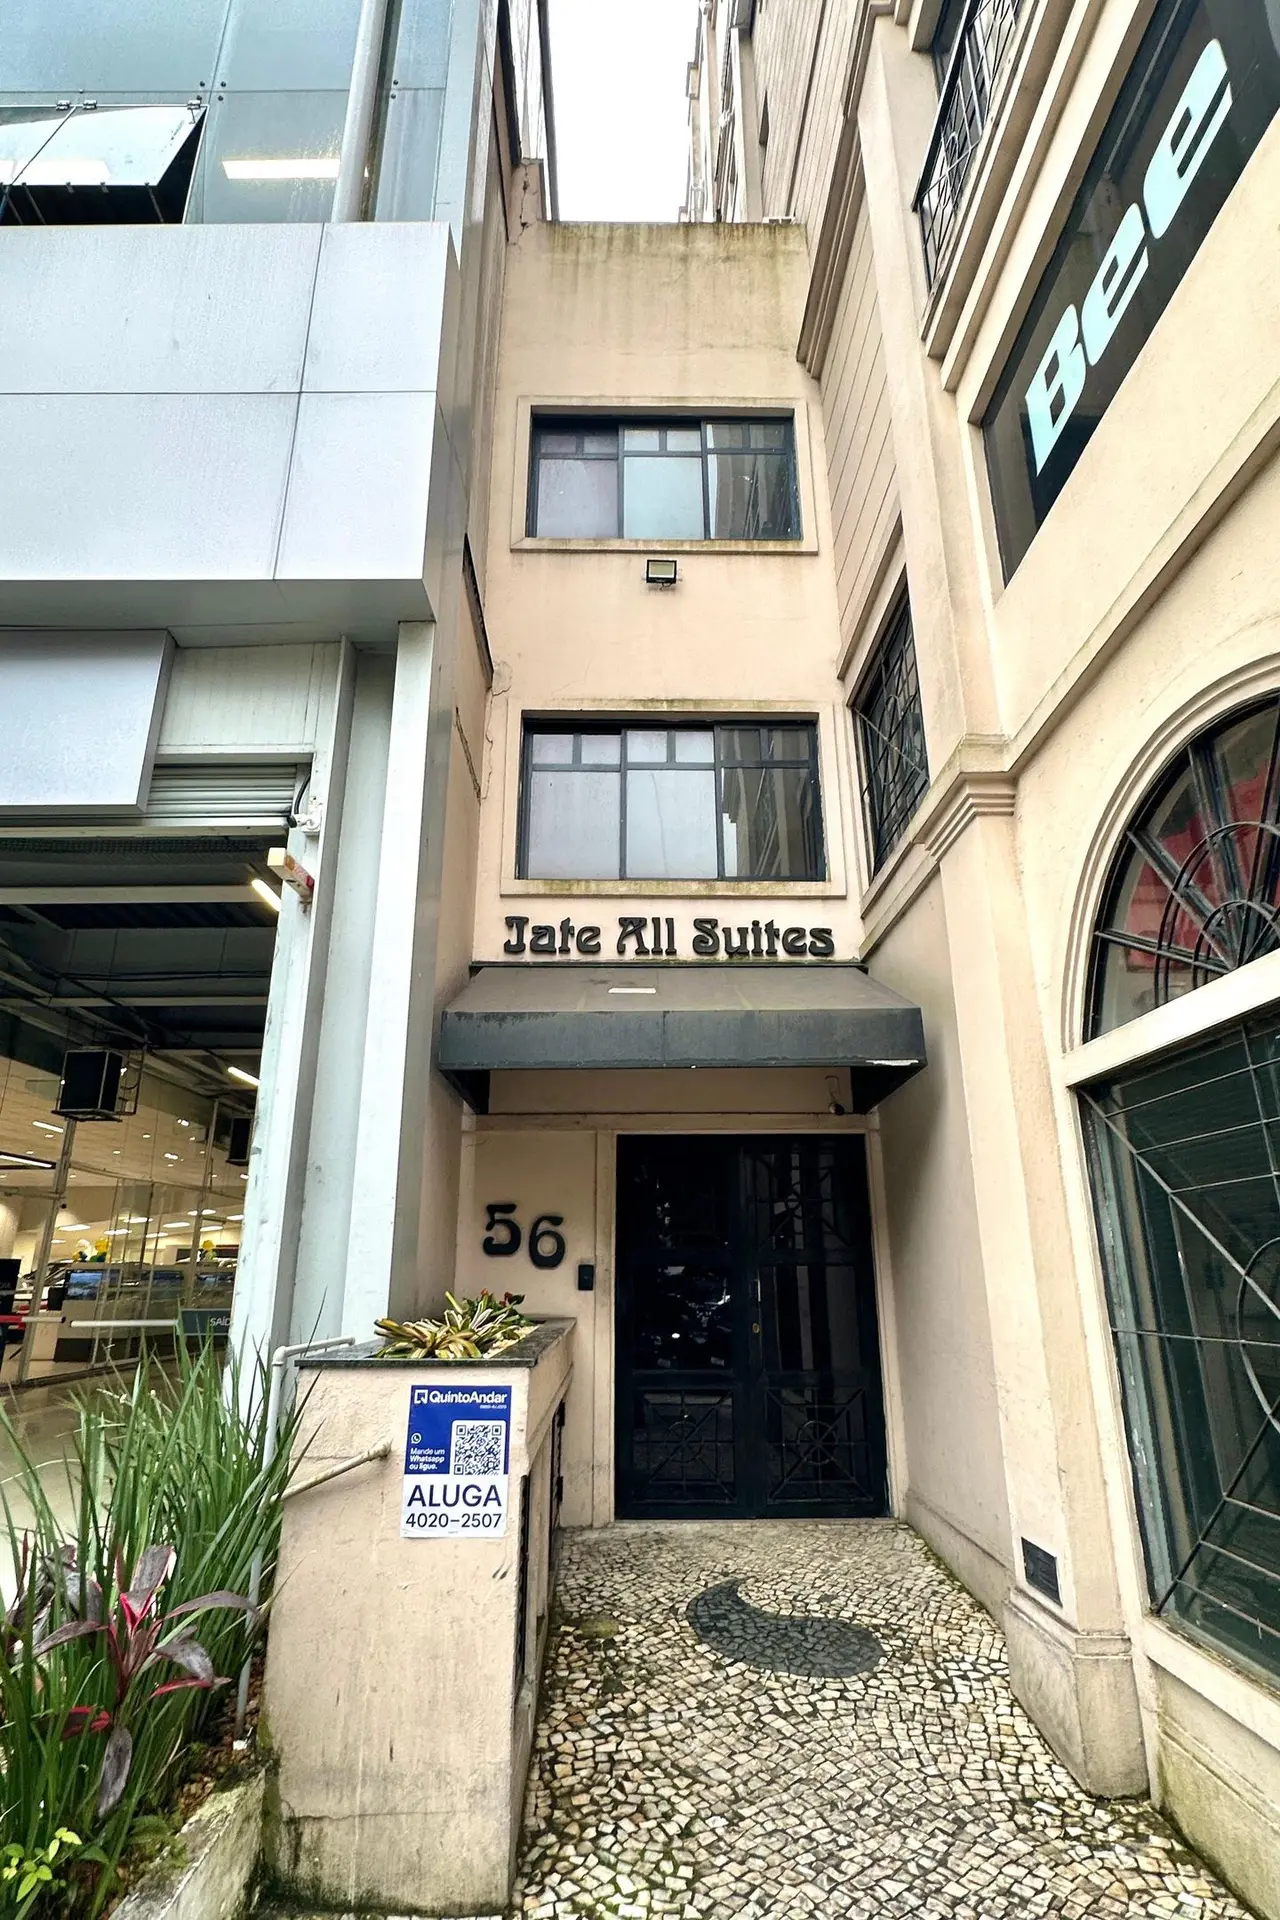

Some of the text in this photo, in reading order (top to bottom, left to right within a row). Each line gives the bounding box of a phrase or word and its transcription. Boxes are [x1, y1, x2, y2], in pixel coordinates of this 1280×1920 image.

[1025, 38, 1233, 477] Bee
[616, 916, 678, 955] All
[692, 917, 835, 956] Suites
[482, 1203, 566, 1269] 56
[429, 1391, 507, 1404] QuintoAndar
[407, 1484, 502, 1507] ALUGA
[406, 1513, 502, 1528] 4020-2507
